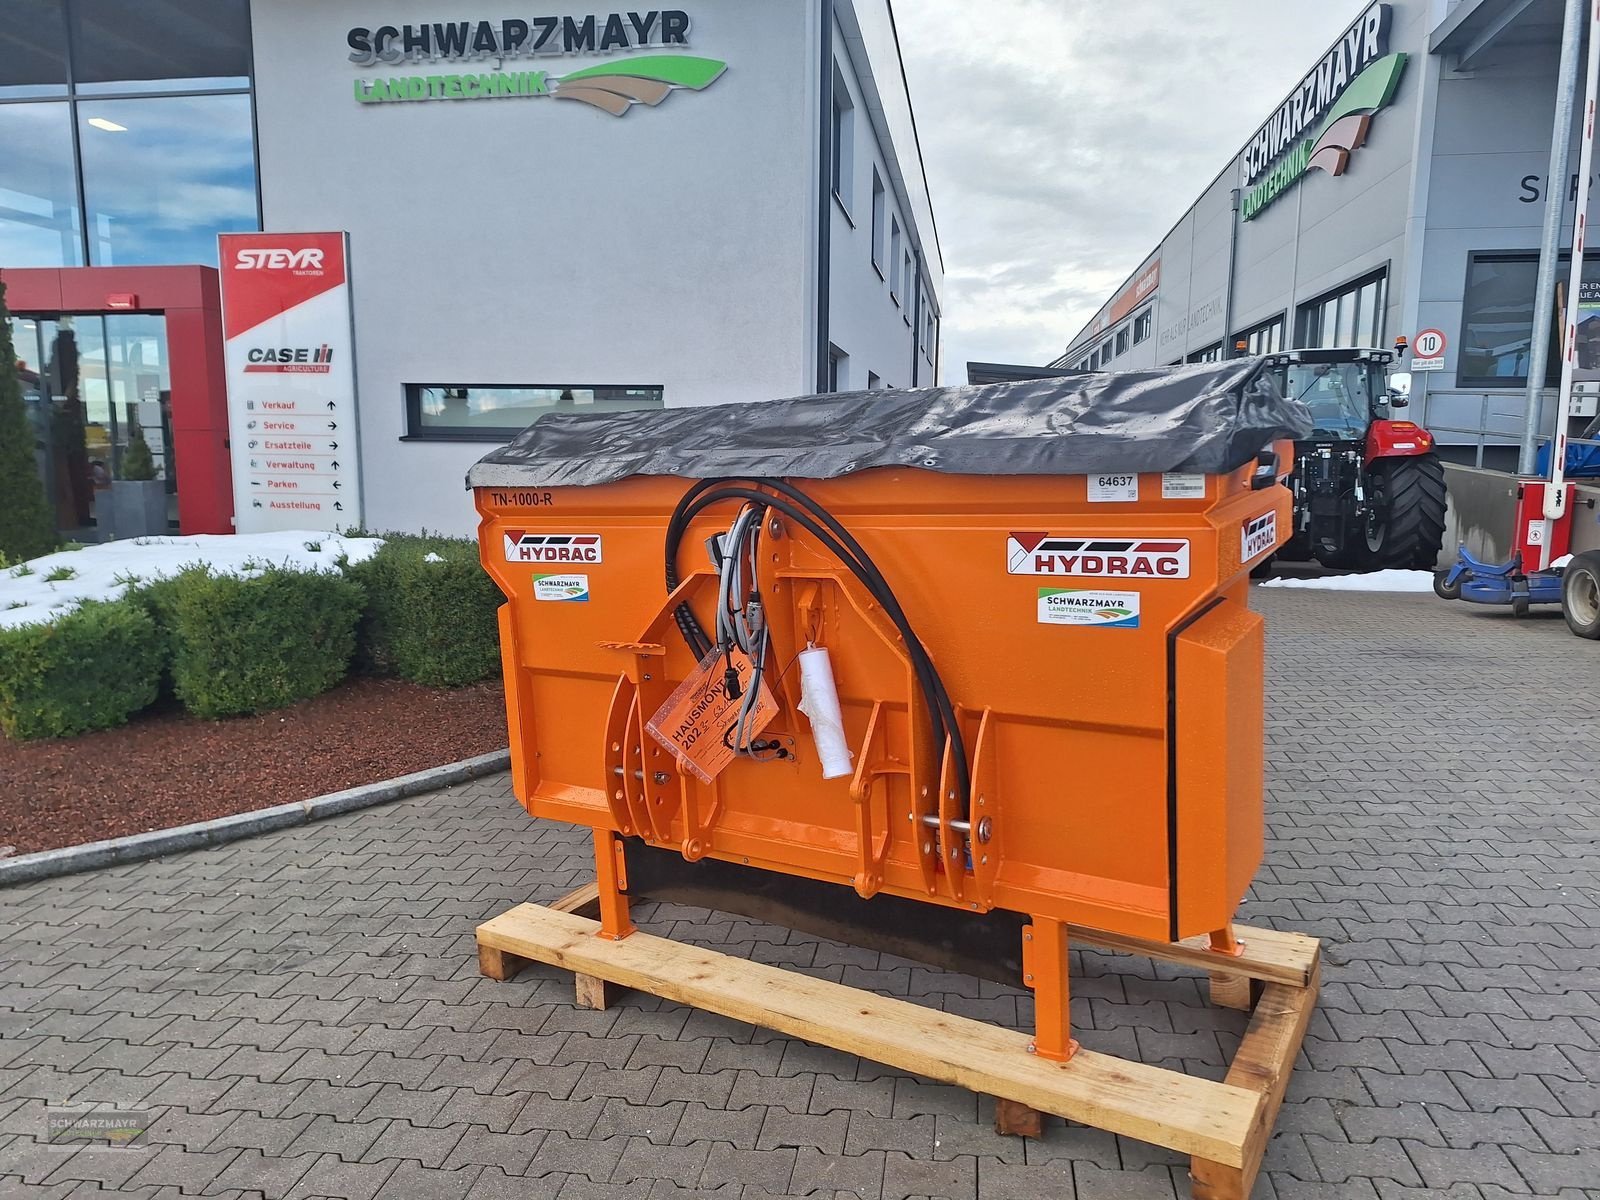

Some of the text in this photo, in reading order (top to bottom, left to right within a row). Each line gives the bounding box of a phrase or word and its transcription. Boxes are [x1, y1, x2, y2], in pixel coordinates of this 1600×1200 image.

[346, 10, 691, 66] SCHWARZMAYR
[353, 71, 550, 103] LANDTECHNIK
[1242, 4, 1391, 187] SCHWARZMAYR
[1242, 139, 1313, 222] LANDTECHNIK
[234, 248, 324, 270] STEYR
[1423, 336, 1436, 351] 10
[247, 348, 309, 363] CASE
[262, 401, 296, 409] Verkauf
[263, 421, 295, 430] Service
[264, 441, 312, 450] Ersatzteile
[266, 460, 315, 470] Verwaltung
[267, 480, 298, 489] Parken
[1098, 476, 1133, 487] 64637
[270, 501, 321, 511] Ausstellung
[491, 492, 553, 506] TN-1000-R
[1247, 526, 1274, 557] HYDRAC
[519, 547, 597, 561] HYDRAC
[1034, 555, 1179, 576] HYDRAC
[1047, 596, 1125, 608] SCHWARZMAYR
[1048, 606, 1093, 614] LANDTECHNIK
